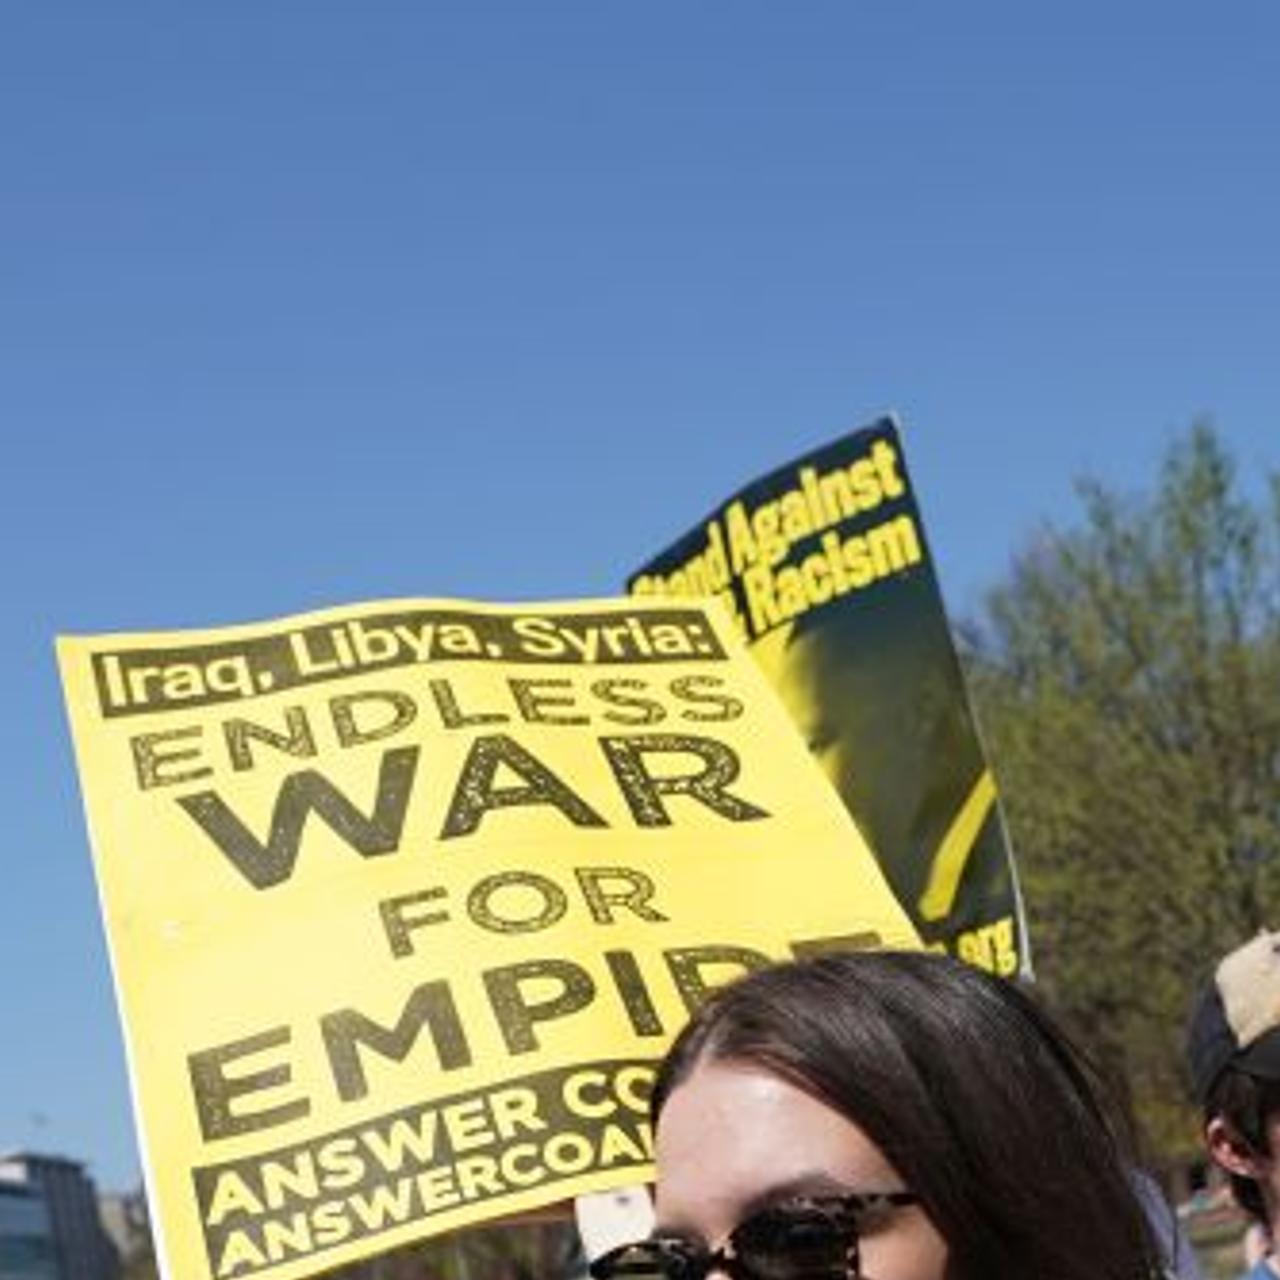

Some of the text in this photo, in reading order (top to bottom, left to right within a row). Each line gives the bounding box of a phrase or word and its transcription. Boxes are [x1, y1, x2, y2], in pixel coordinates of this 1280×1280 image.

[726, 438, 904, 575] Against
[742, 515, 920, 638] Racism
[104, 652, 272, 710] Iraq,
[293, 614, 502, 675] Libya,
[518, 615, 718, 666] Syria:
[130, 674, 745, 790] ENDLESS
[177, 733, 771, 891] WAR
[378, 866, 670, 958] FOR
[188, 932, 882, 1141] EMPI
[207, 1086, 542, 1228] ANSWER
